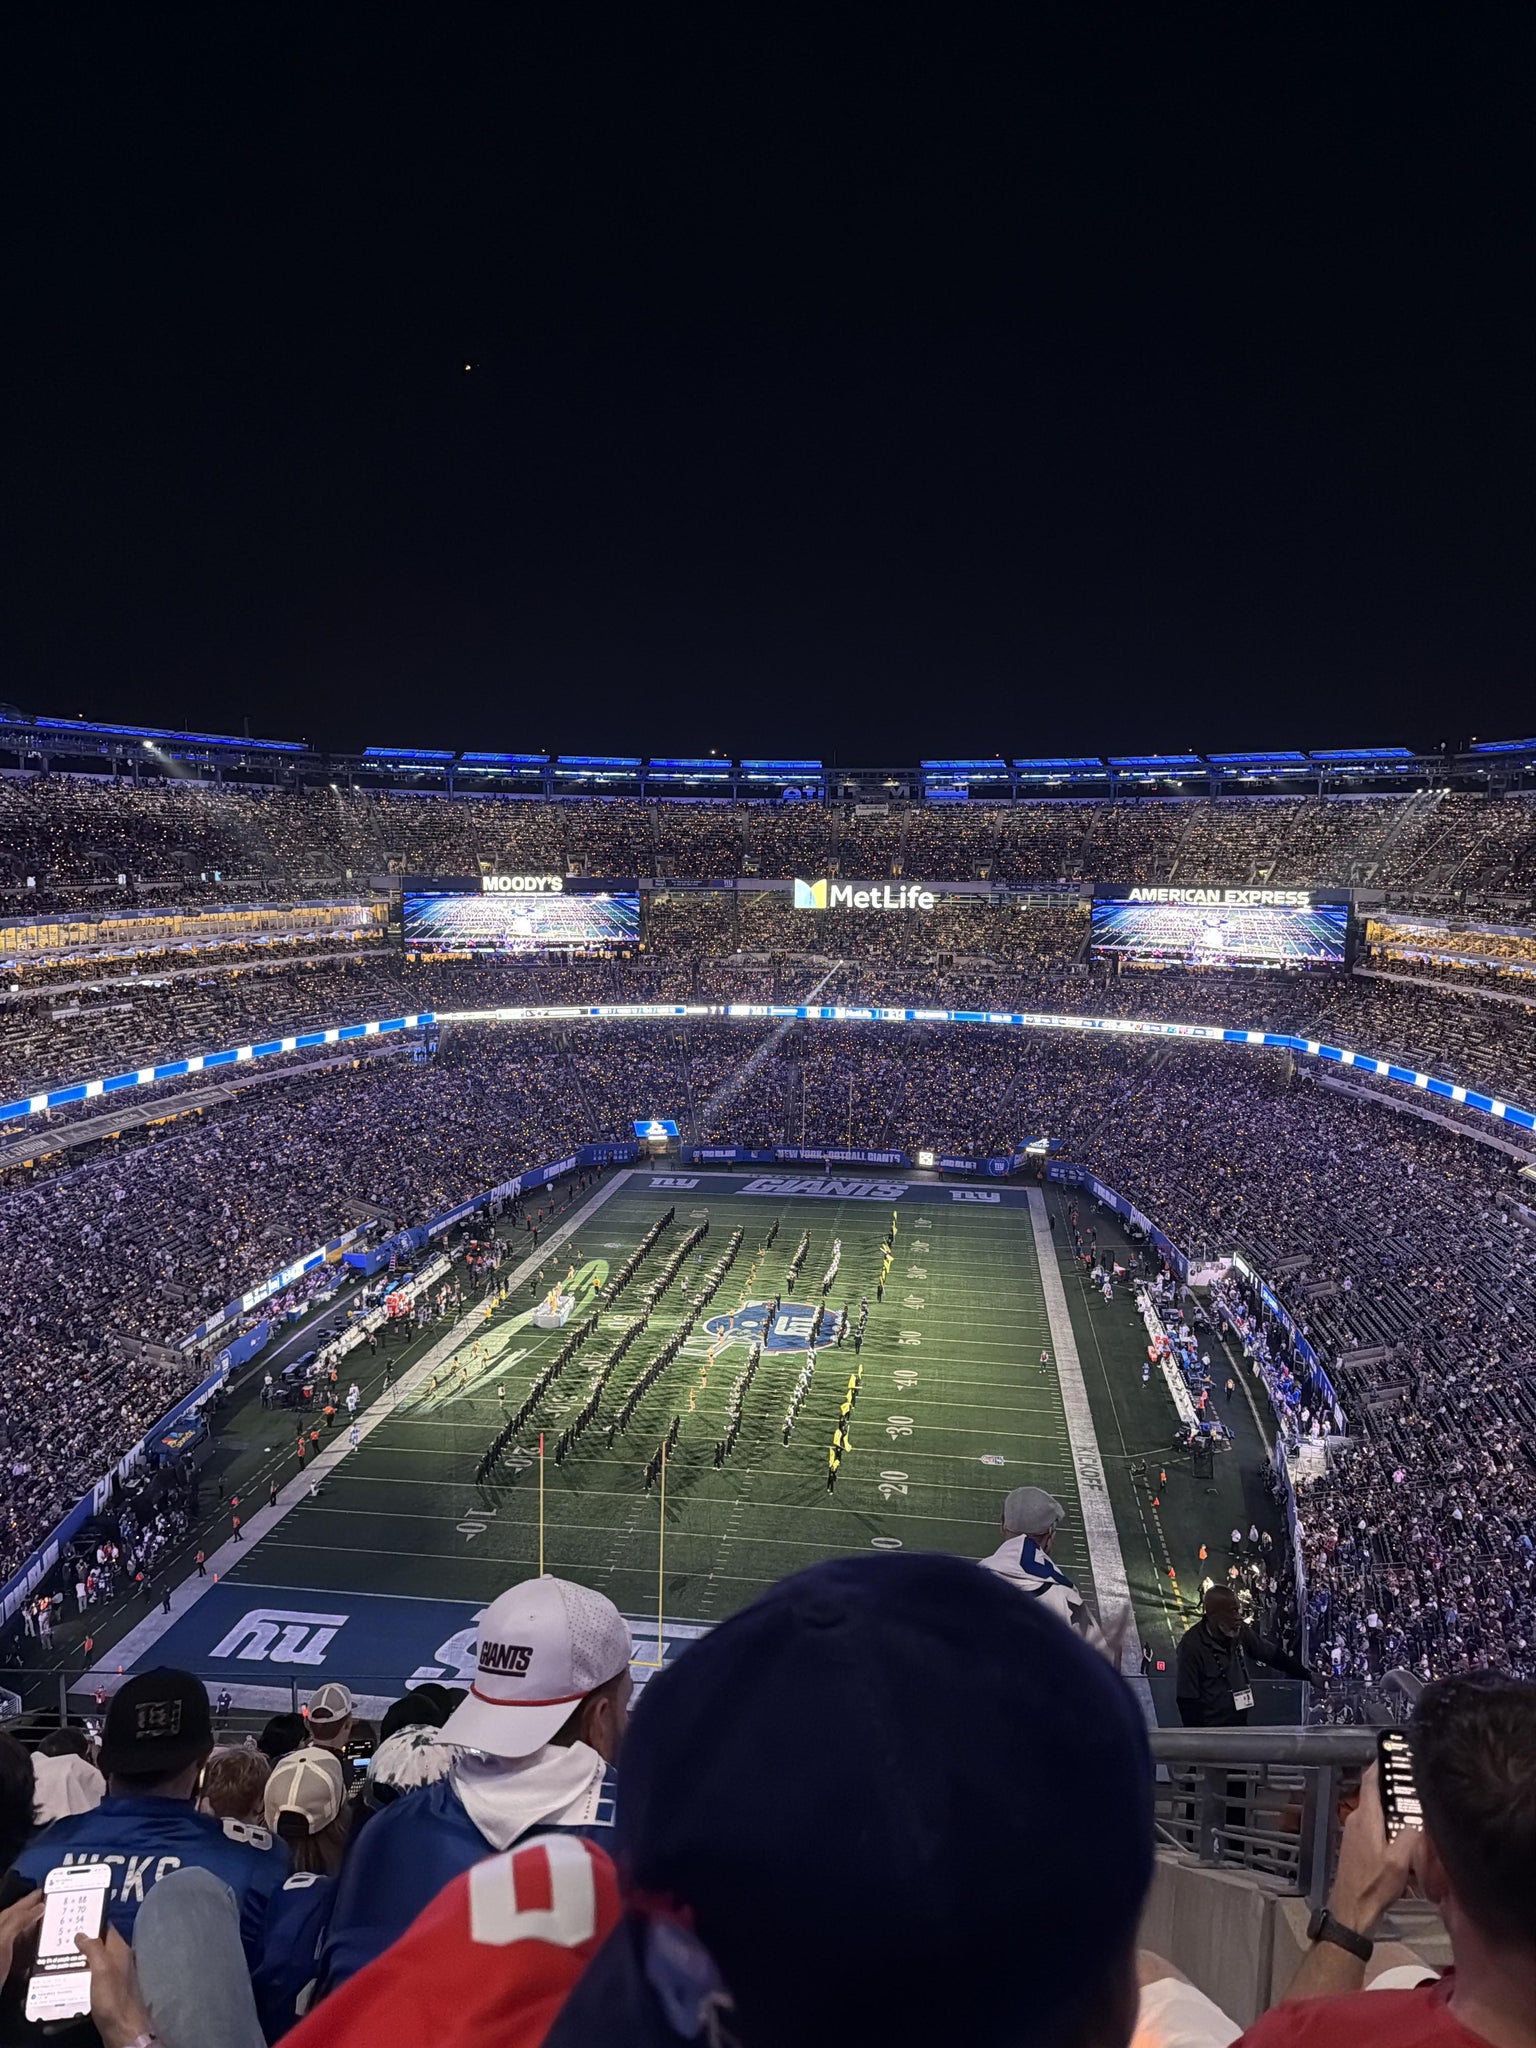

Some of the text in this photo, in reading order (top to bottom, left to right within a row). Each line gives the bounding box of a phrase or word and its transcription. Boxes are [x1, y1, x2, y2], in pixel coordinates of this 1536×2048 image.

[482, 876, 563, 891] MOODY'S
[830, 884, 934, 909] MetLife
[1128, 888, 1310, 905] AMERICAN EXPRESS
[867, 1152, 901, 1163] GIANTS
[742, 1178, 910, 1199] GIANTS
[893, 1370, 919, 1387] 40
[886, 1415, 914, 1437] 30
[1076, 1445, 1104, 1492] KICKOFF
[877, 1470, 909, 1495] 20
[455, 1507, 498, 1534] 10
[478, 1640, 533, 1671] GIANTS
